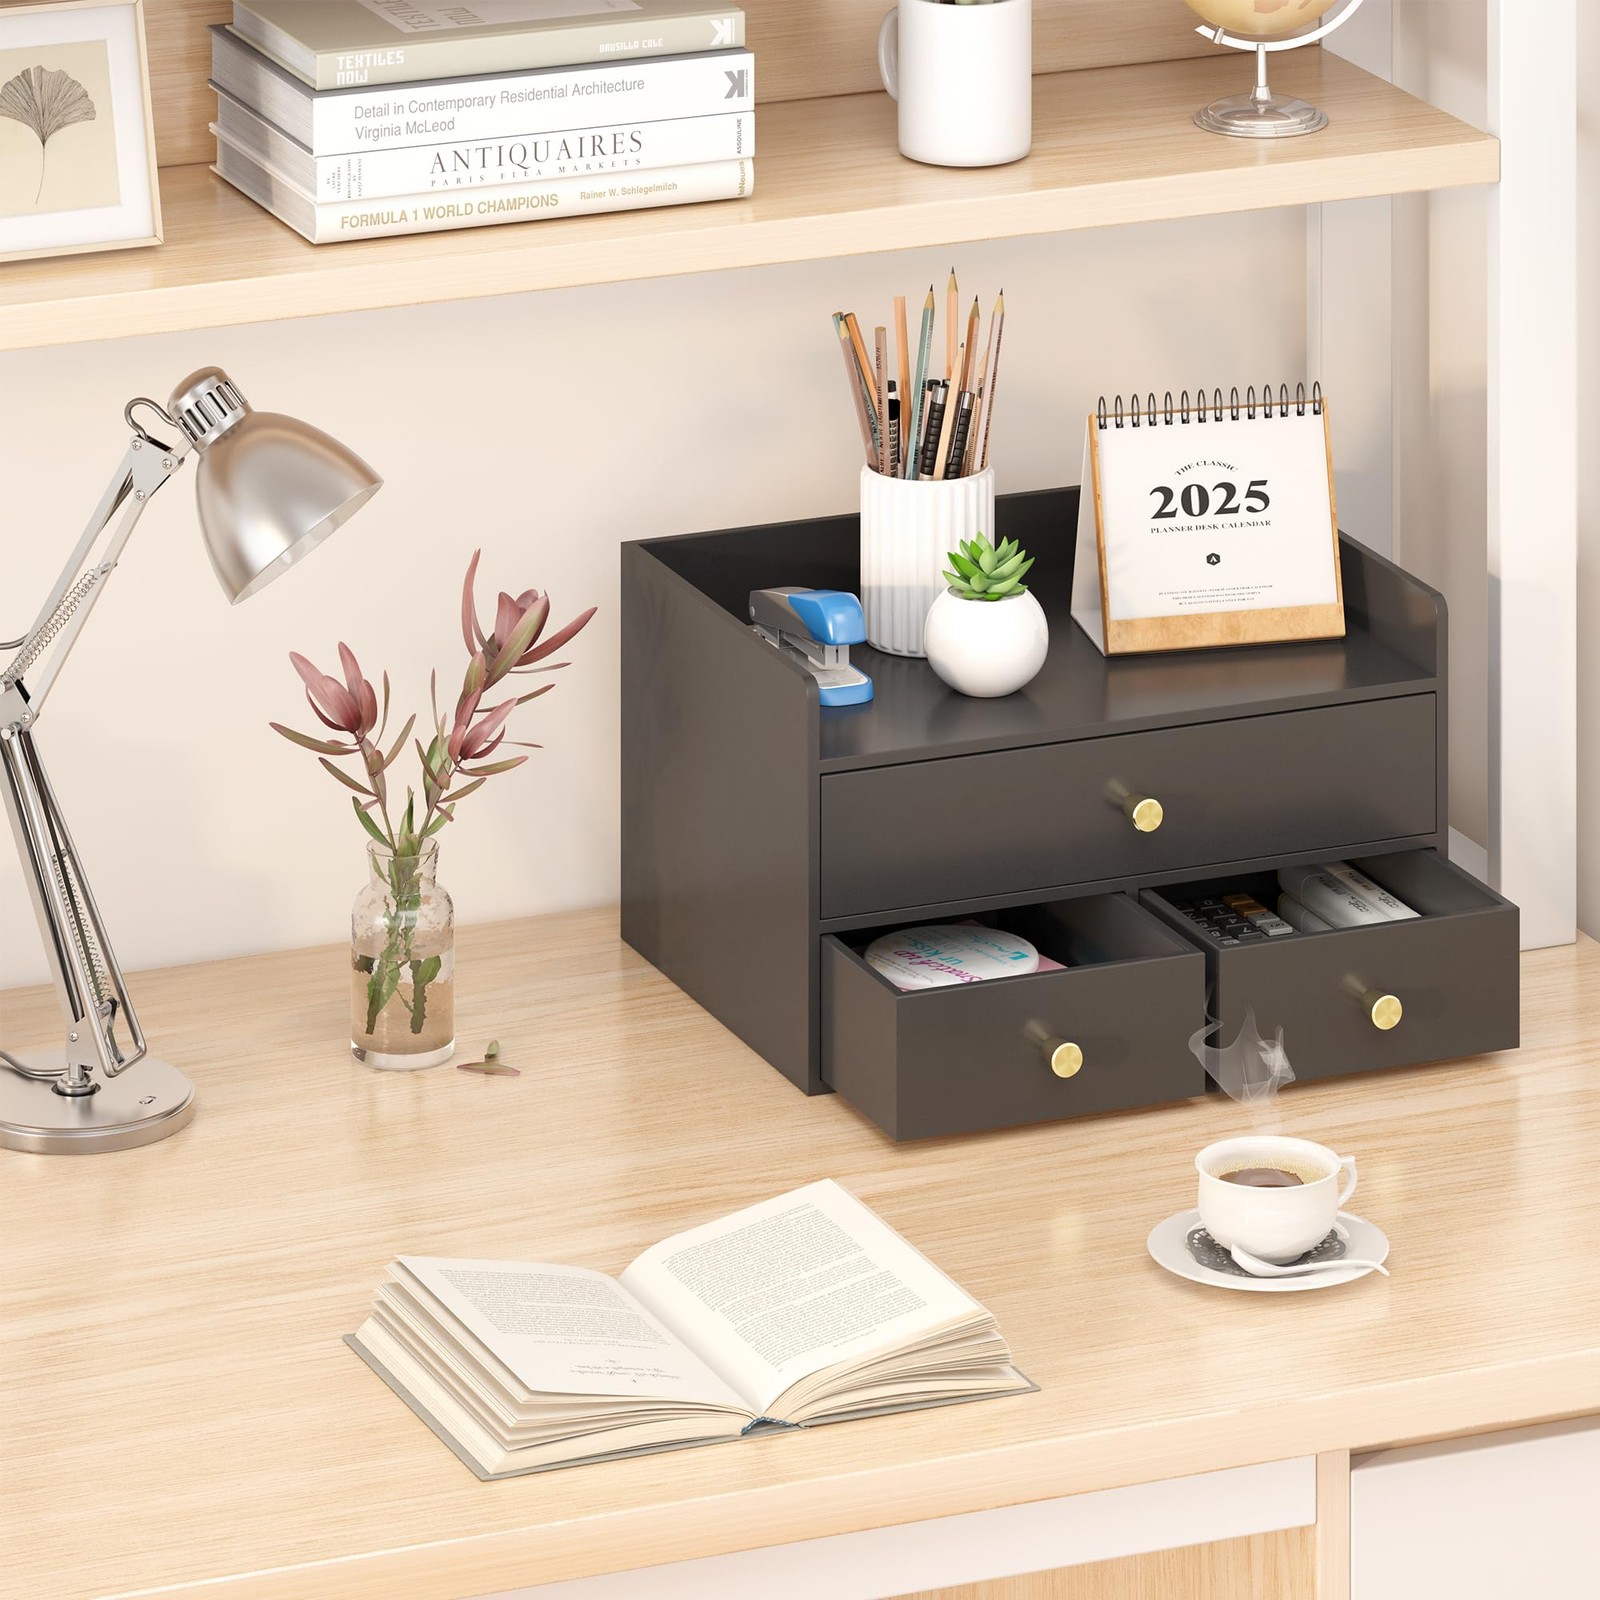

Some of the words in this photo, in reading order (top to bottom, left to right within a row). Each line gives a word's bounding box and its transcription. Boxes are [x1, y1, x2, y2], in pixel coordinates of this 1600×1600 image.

[642, 38, 664, 48] COLE
[336, 51, 405, 71] TEXTILES
[336, 69, 369, 86] NOW
[354, 103, 390, 119] Detail
[393, 101, 404, 115] in
[408, 95, 497, 114] Contemporary
[500, 84, 568, 105] Residential
[571, 79, 645, 97] Architecture
[355, 123, 402, 142] Virginia
[405, 117, 456, 135] McLeod
[429, 130, 643, 174] ANTIQUAIRES
[431, 175, 485, 187] PARIS
[500, 169, 542, 180] FLEA
[558, 158, 641, 174] MARKETS
[580, 191, 607, 201] Rainer
[608, 188, 619, 198] W.
[621, 182, 678, 197] Schlegelmilch
[341, 210, 409, 230] FORMULA
[412, 208, 419, 222] 1
[423, 203, 474, 221] WORLD
[477, 194, 559, 215] CHAMPIONS
[1174, 462, 1195, 476] THE
[1196, 460, 1239, 473] CLASSIC
[1149, 480, 1270, 519] 2025
[1150, 525, 1194, 534] PLANNER
[1195, 523, 1219, 531] DESK
[1221, 520, 1272, 530] CALENDAR
